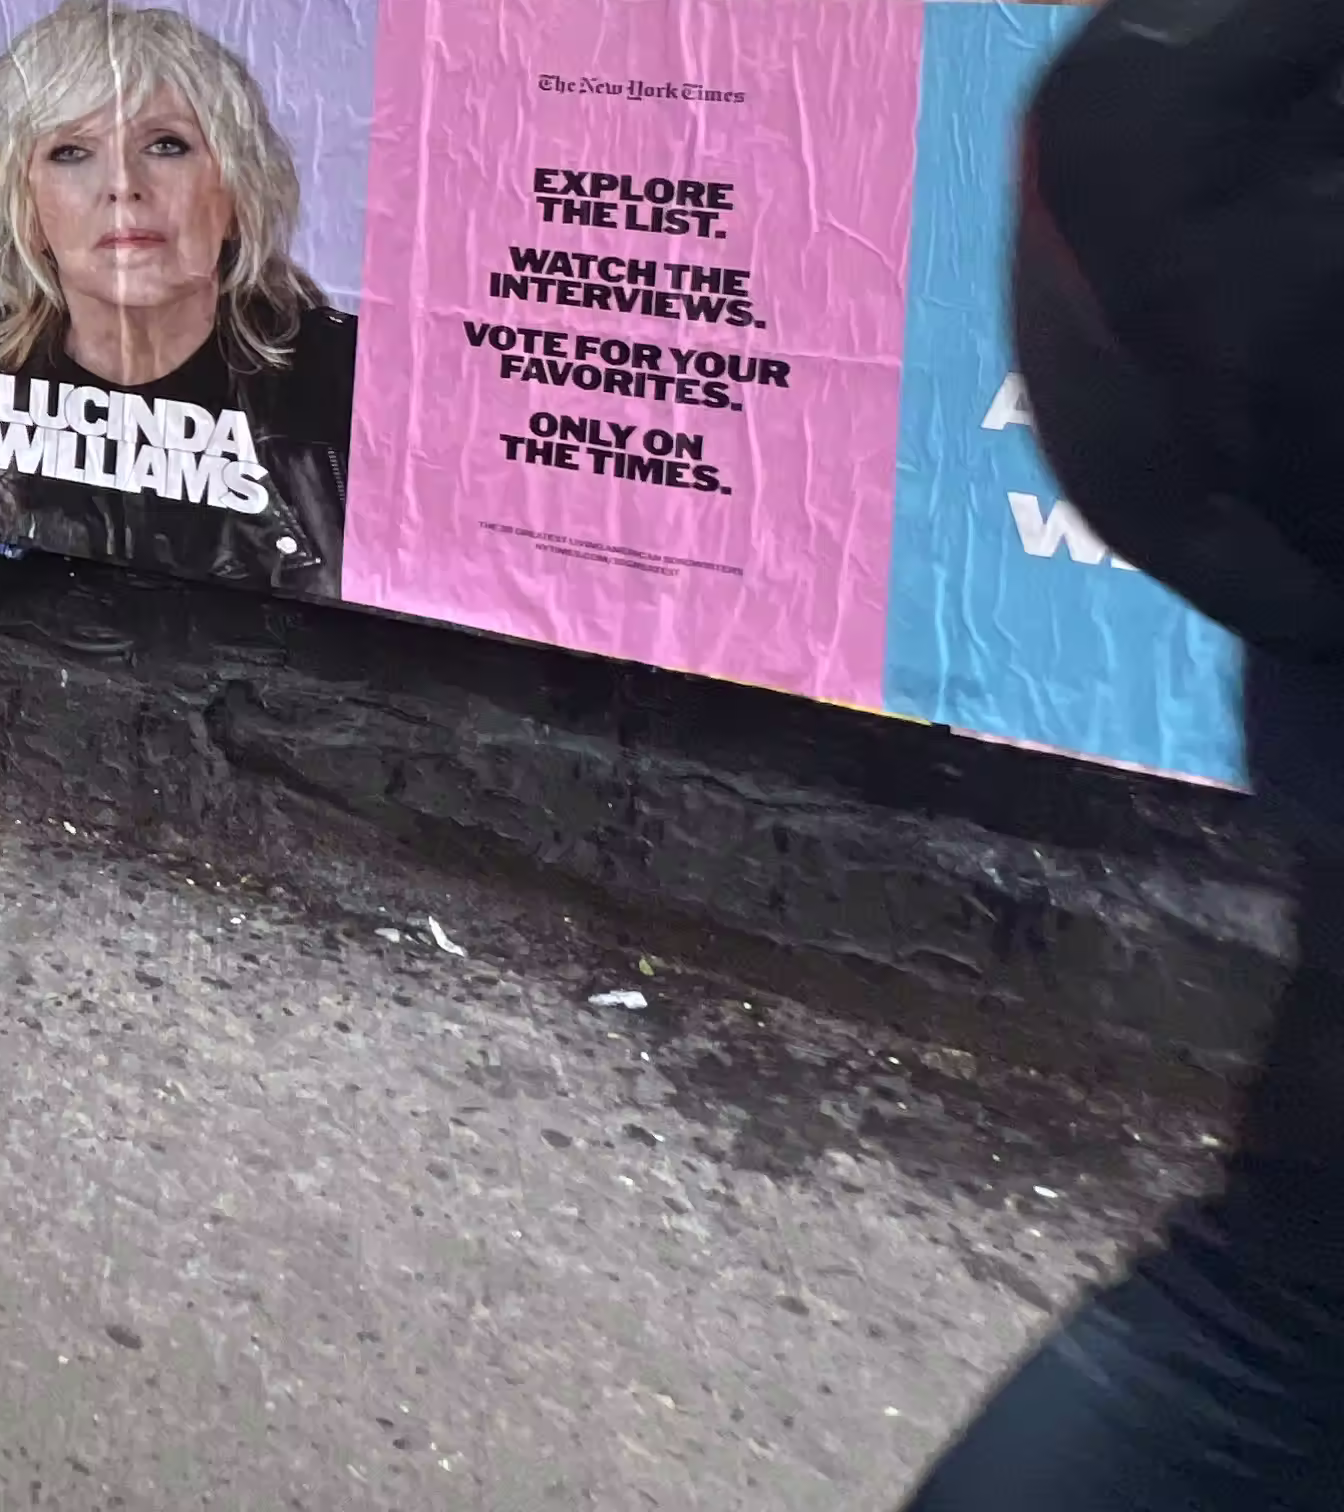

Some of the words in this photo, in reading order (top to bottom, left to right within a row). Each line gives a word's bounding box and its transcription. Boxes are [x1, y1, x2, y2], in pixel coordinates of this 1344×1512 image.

[538, 74, 577, 93] The
[579, 76, 623, 95] New
[626, 79, 678, 101] York
[681, 82, 746, 103] Times
[533, 168, 734, 210] EXPLORE
[536, 196, 618, 229] THE
[625, 204, 727, 239] LIST.
[509, 246, 657, 287] WATCH
[663, 263, 750, 297] THE
[489, 272, 766, 329] INTERVIEWS.
[463, 320, 568, 359] VOTE
[574, 335, 663, 371] FOR
[668, 347, 791, 388] YOUR
[500, 354, 743, 411] FAVORITES.
[529, 411, 637, 450] ONLY
[642, 429, 704, 461] ON
[499, 433, 580, 471] THE
[586, 447, 732, 495] TIMES.
